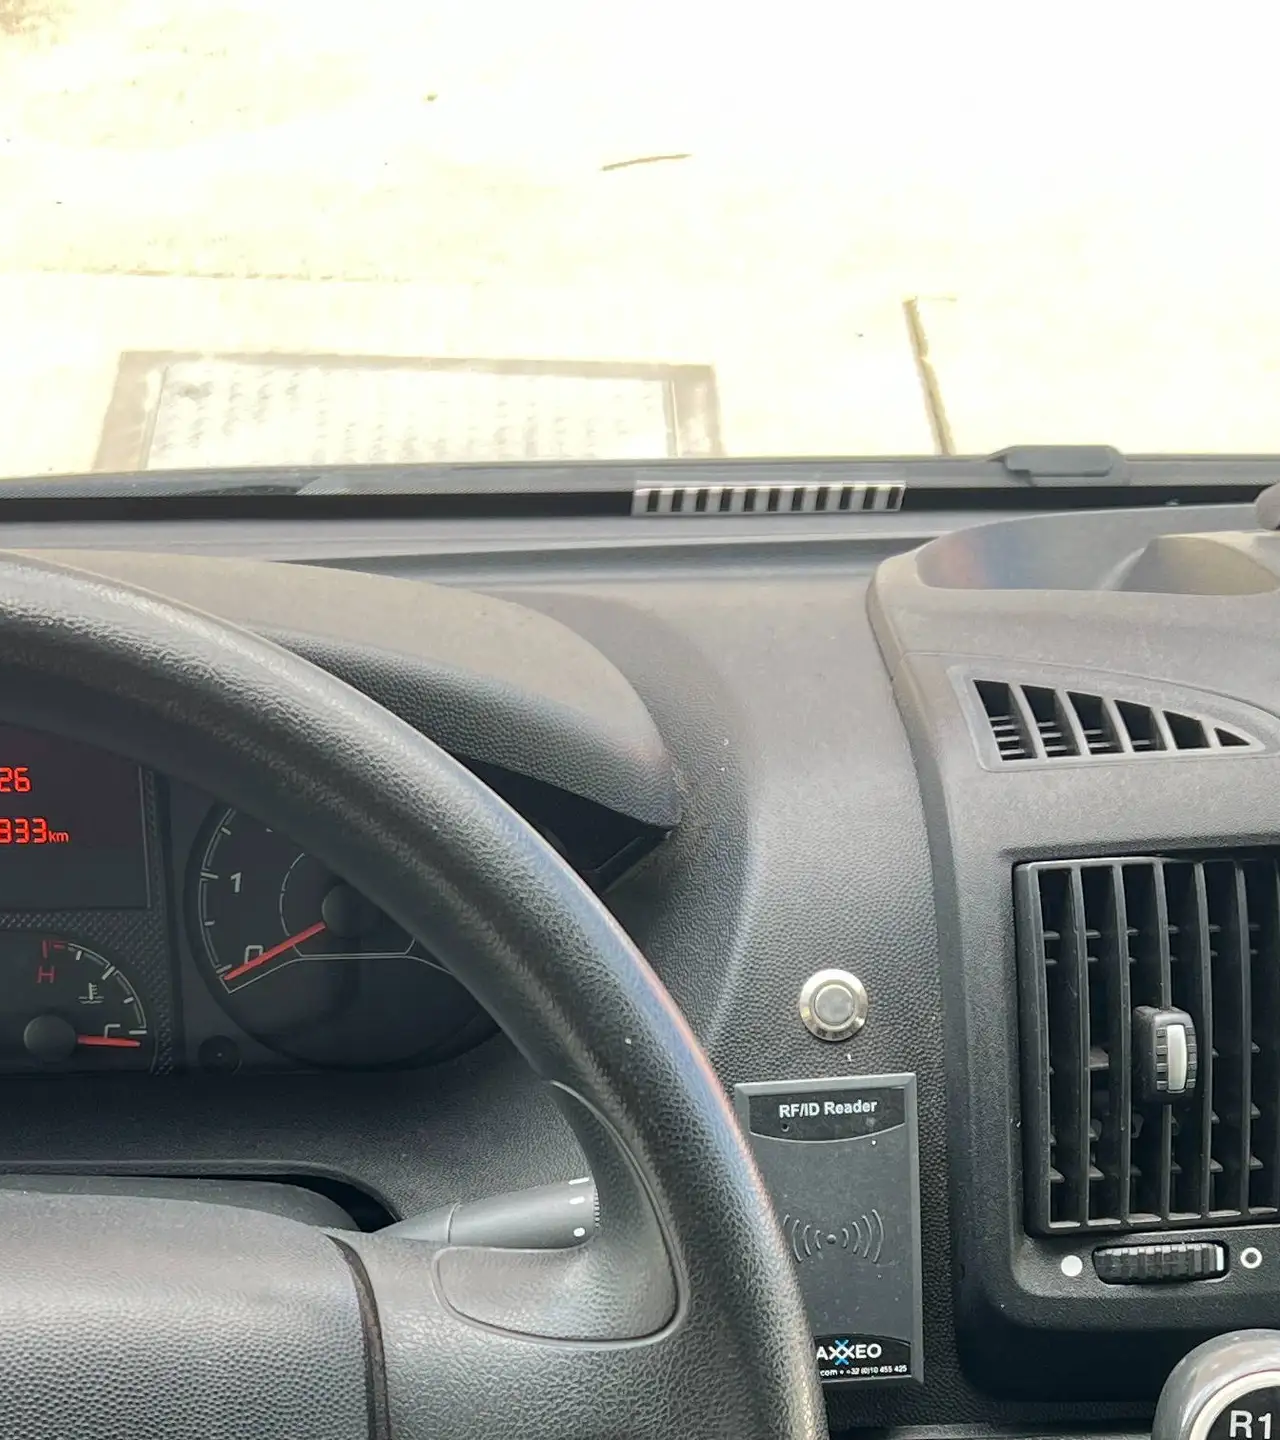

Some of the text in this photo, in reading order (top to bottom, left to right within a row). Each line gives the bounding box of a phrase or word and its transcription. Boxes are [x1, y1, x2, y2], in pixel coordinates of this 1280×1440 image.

[230, 871, 241, 892] 1
[35, 965, 55, 983] H
[778, 1099, 877, 1118] RF/ID Reader
[1229, 1410, 1252, 1438] R
[1258, 1413, 1271, 1439] 1
